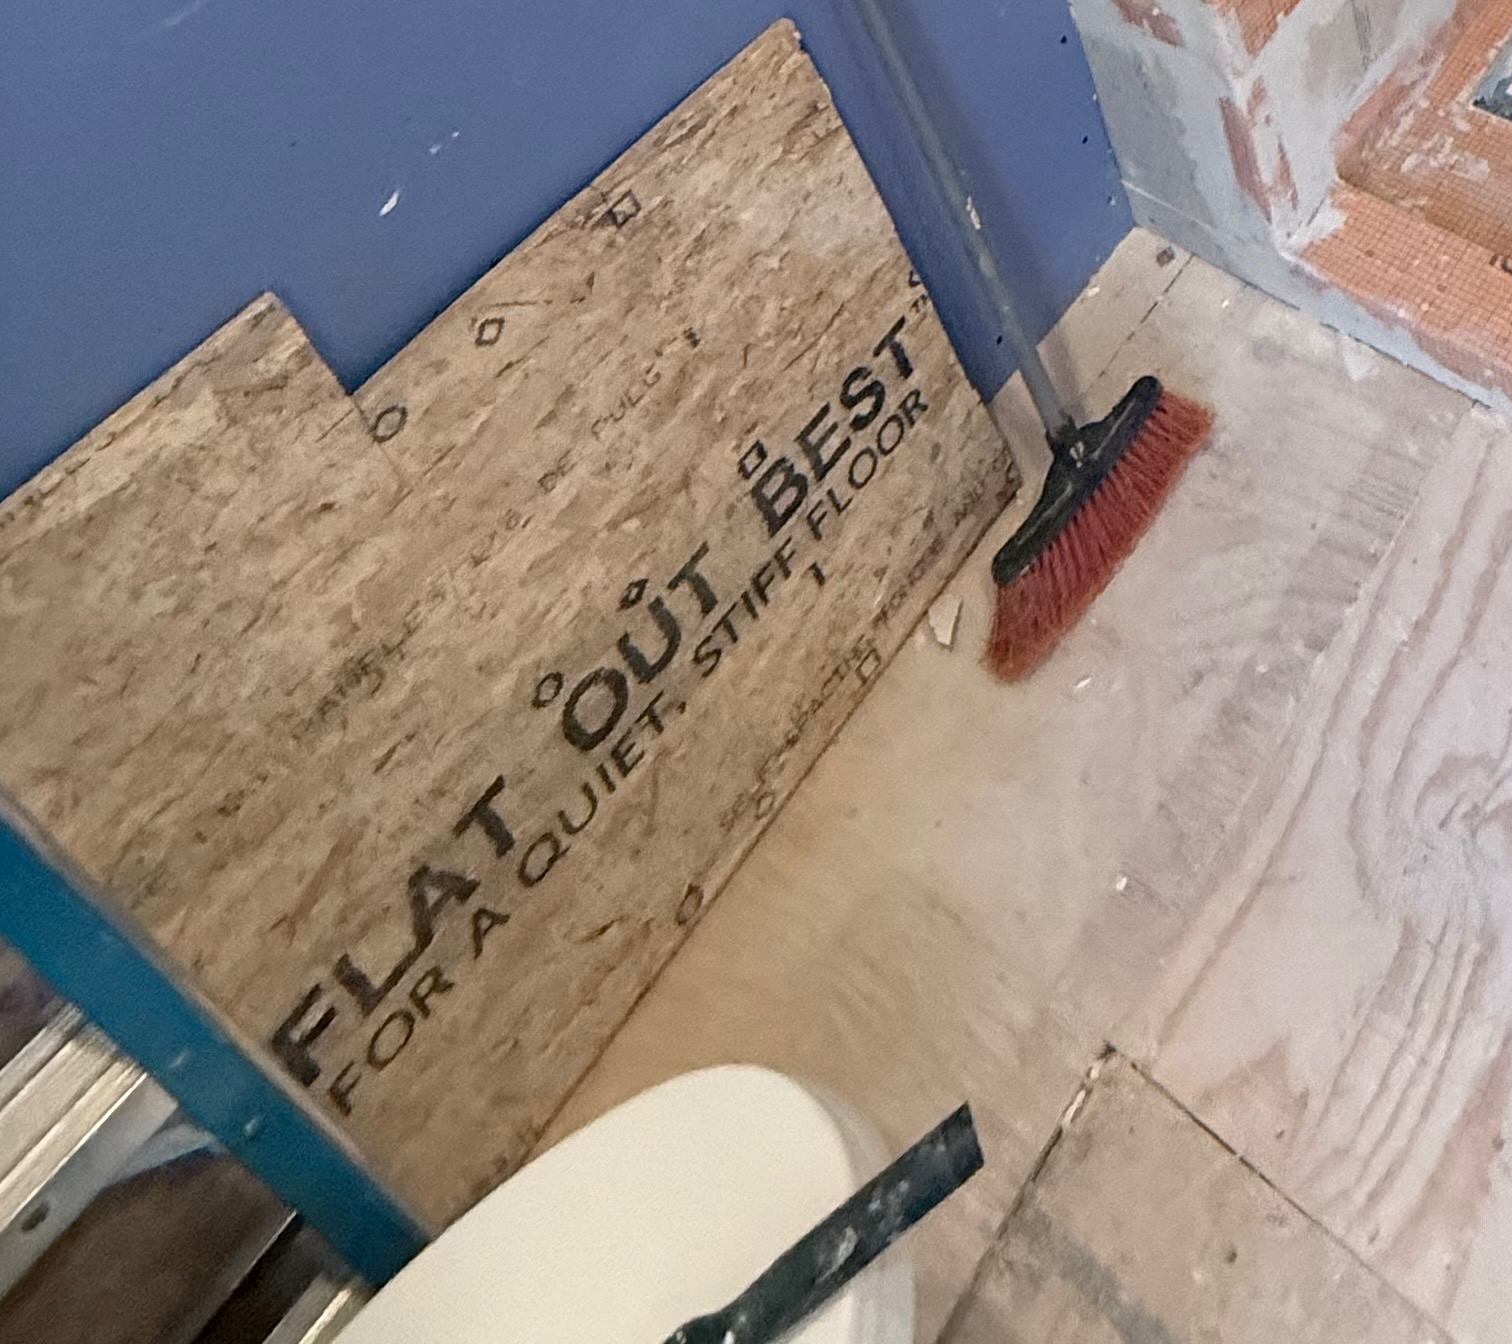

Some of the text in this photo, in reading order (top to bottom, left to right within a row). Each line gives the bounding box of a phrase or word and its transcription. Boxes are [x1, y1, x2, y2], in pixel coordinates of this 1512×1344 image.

[271, 774, 515, 1088] FLAT
[562, 541, 719, 753] OUT
[751, 315, 914, 540] BEST
[328, 388, 929, 1118] FOR A QUIET, STIFF FLOOR
